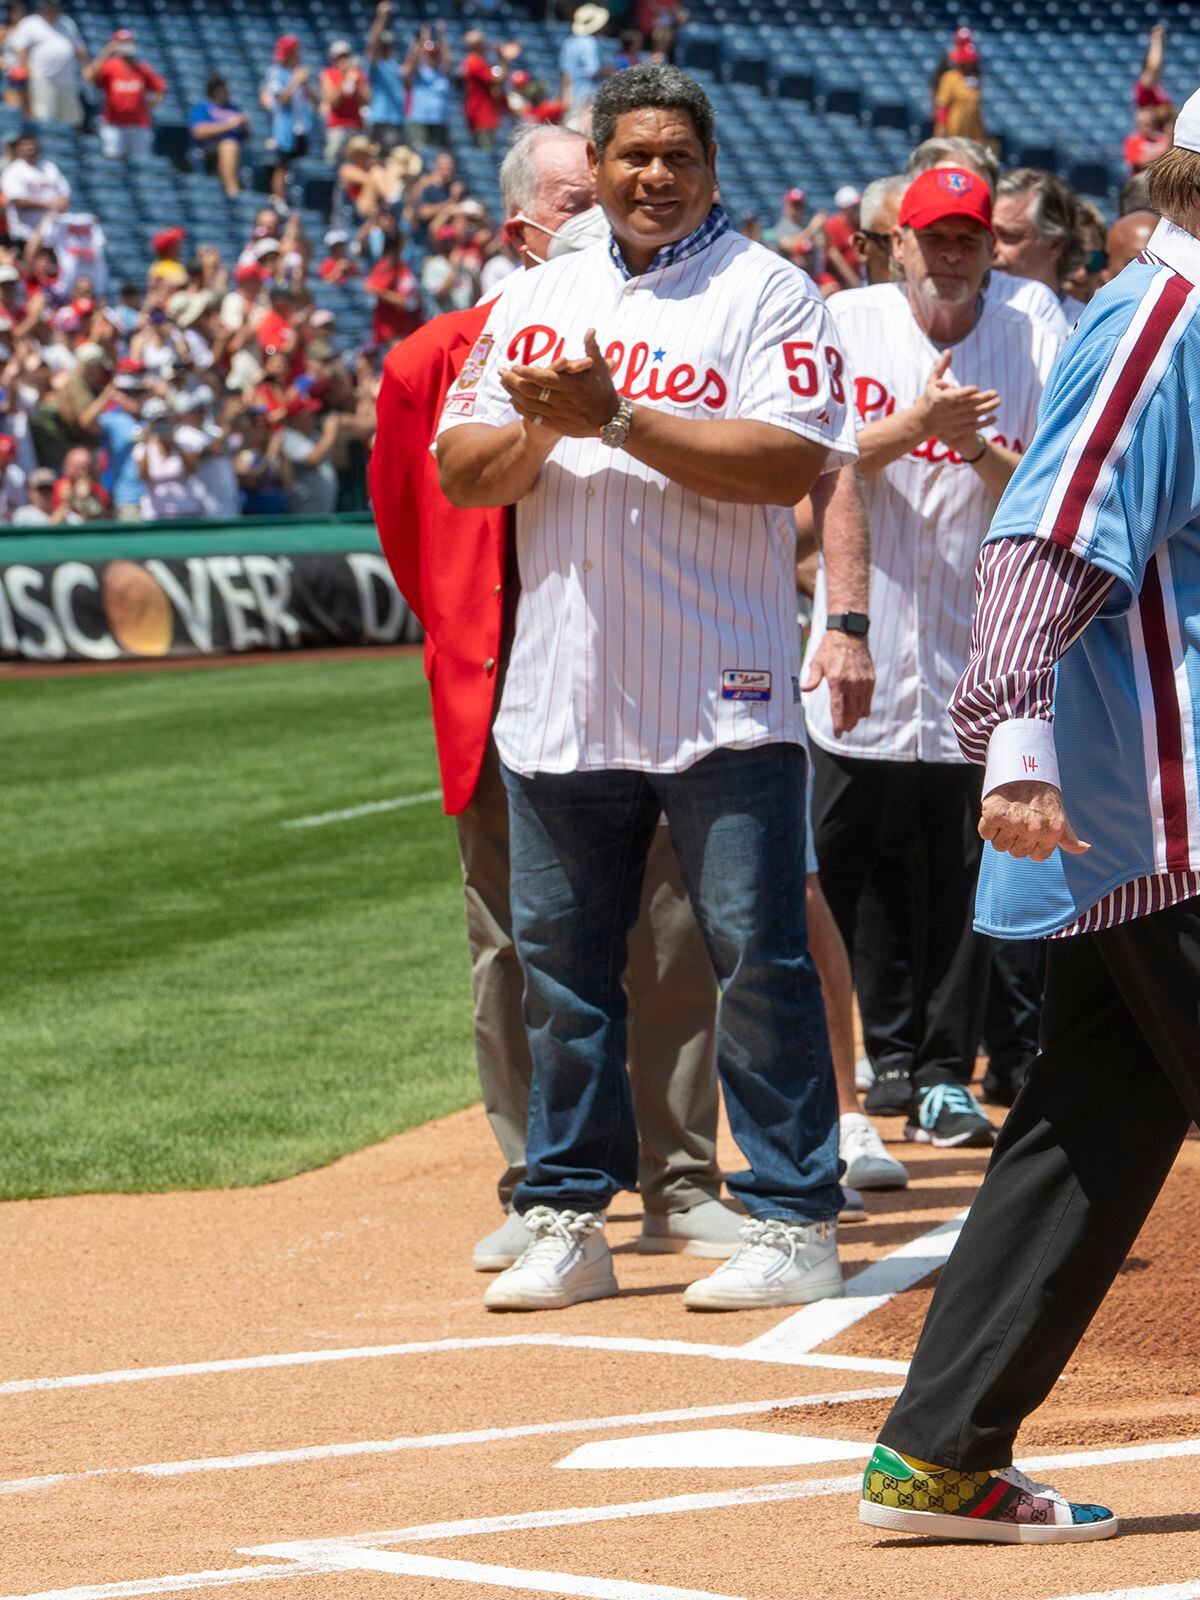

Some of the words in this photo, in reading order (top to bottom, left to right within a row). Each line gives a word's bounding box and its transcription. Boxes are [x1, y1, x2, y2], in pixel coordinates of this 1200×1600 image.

[507, 324, 727, 409] Pllies
[783, 341, 846, 405] 53
[344, 551, 421, 643] D
[1022, 755, 1039, 773] 14
